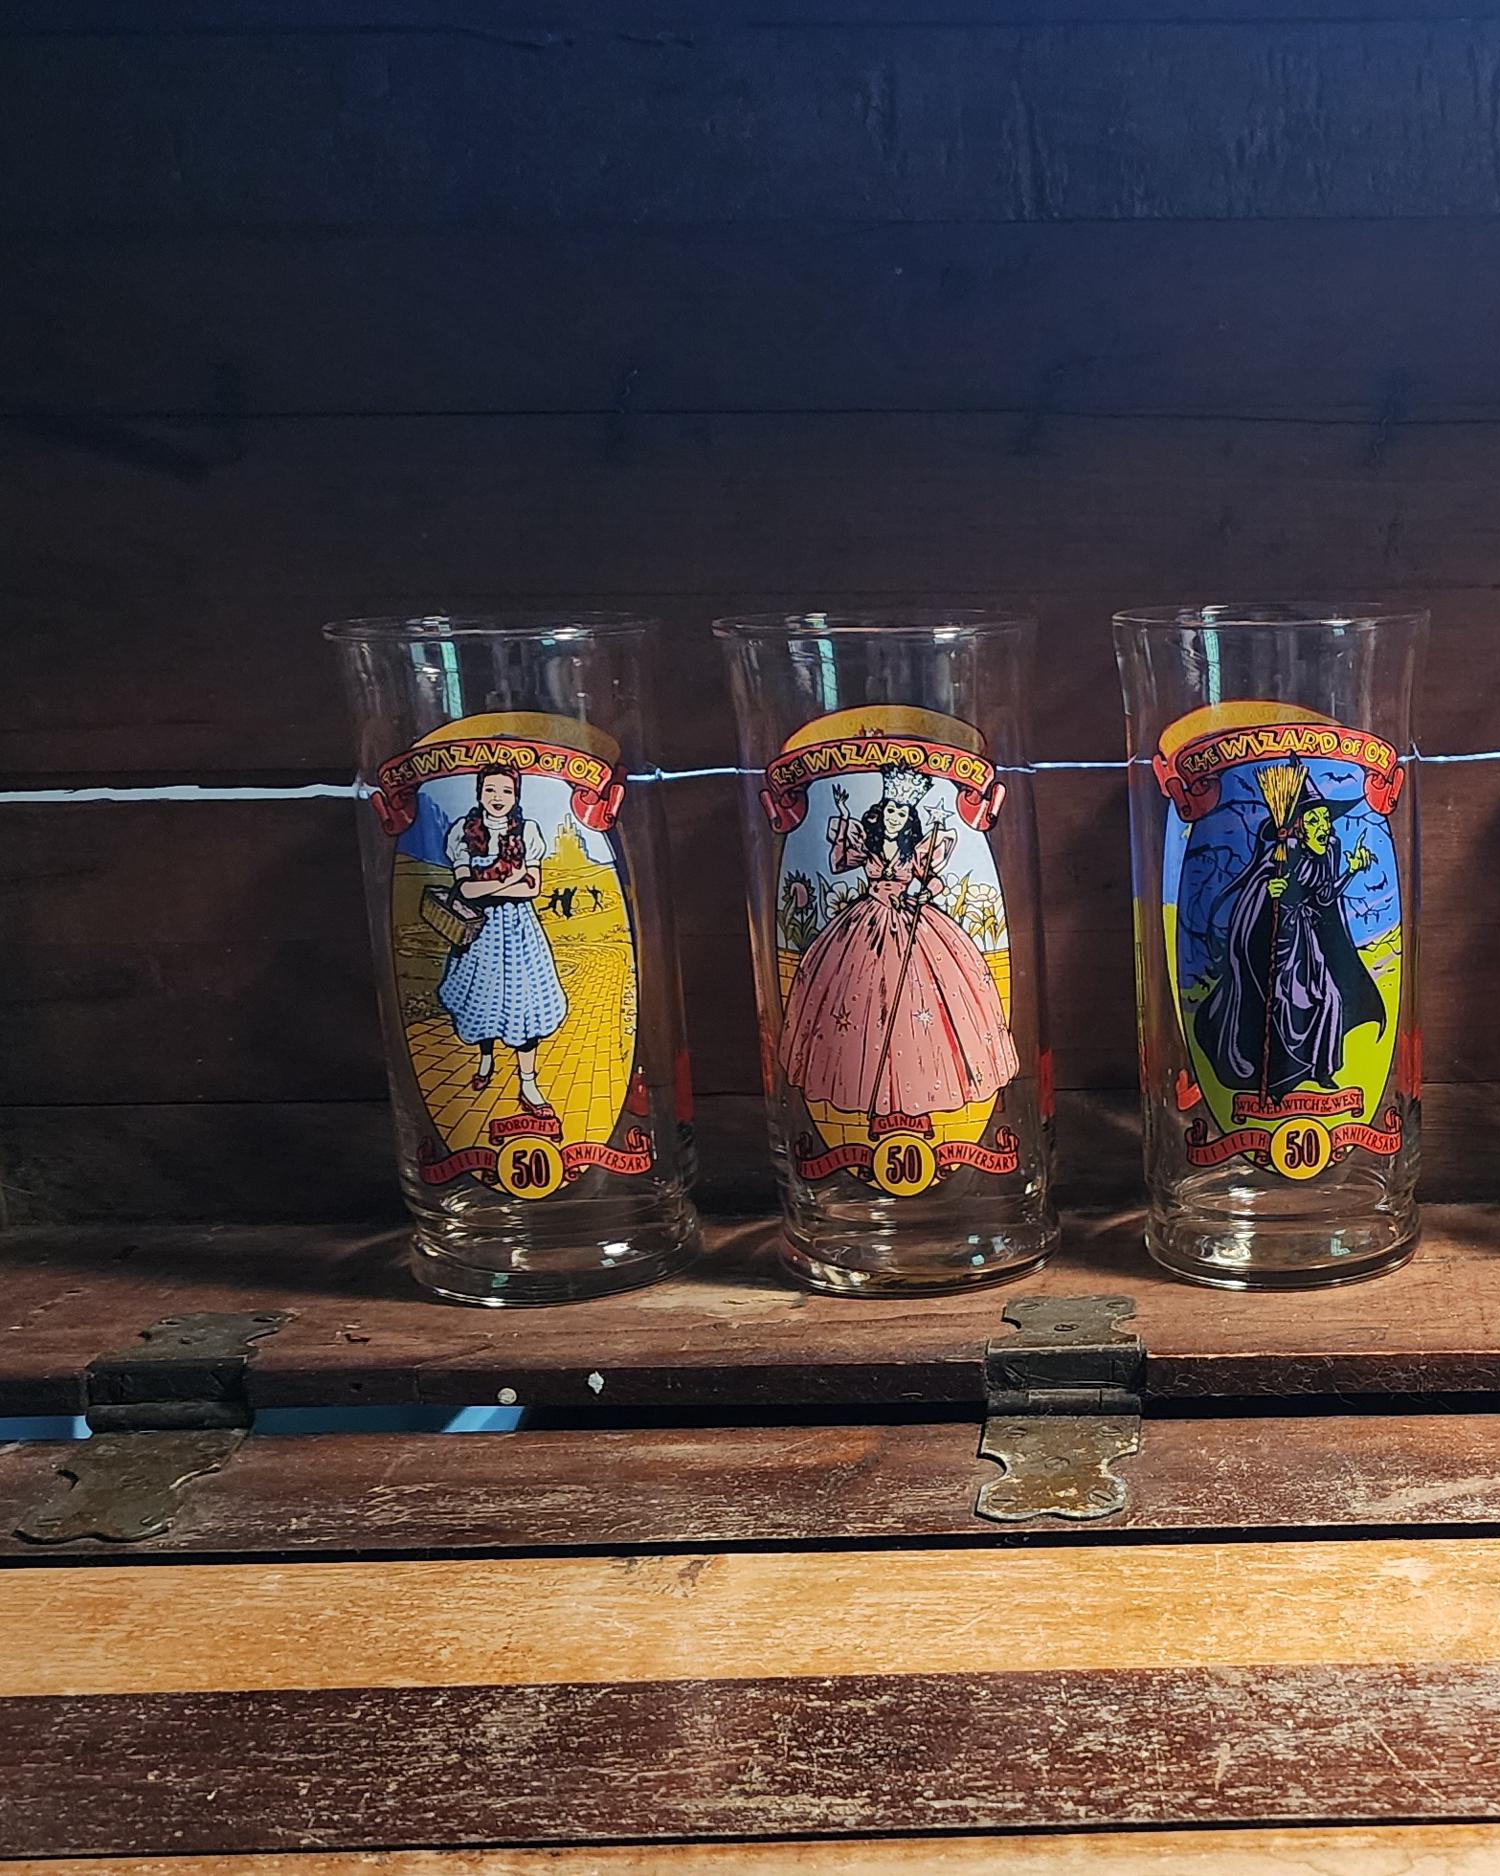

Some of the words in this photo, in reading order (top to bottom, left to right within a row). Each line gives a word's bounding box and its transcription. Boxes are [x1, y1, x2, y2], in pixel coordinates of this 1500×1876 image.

[413, 745, 535, 775] WIZARD
[539, 755, 565, 773] OF
[568, 758, 604, 786] OZ
[772, 760, 804, 784] THE
[803, 743, 925, 770] WIZARD
[927, 753, 953, 769] OF
[955, 757, 987, 784] OZ
[1182, 747, 1219, 772] THE
[1218, 729, 1338, 760] WIZARD
[1340, 739, 1362, 755] OF
[1364, 742, 1393, 769] OZ
[1281, 1098, 1319, 1111] WITCH
[1331, 1093, 1362, 1106] WEST
[496, 1118, 557, 1133] DOROTHY
[878, 1117, 924, 1130] GLINDA
[511, 1149, 551, 1189] 50
[565, 1145, 649, 1171] ANNIVERSARY
[885, 1145, 923, 1183] 50
[938, 1146, 1017, 1170] ANNIVERSARY
[1285, 1129, 1321, 1169] 50
[1335, 1126, 1399, 1151] ANNIVERSARY
